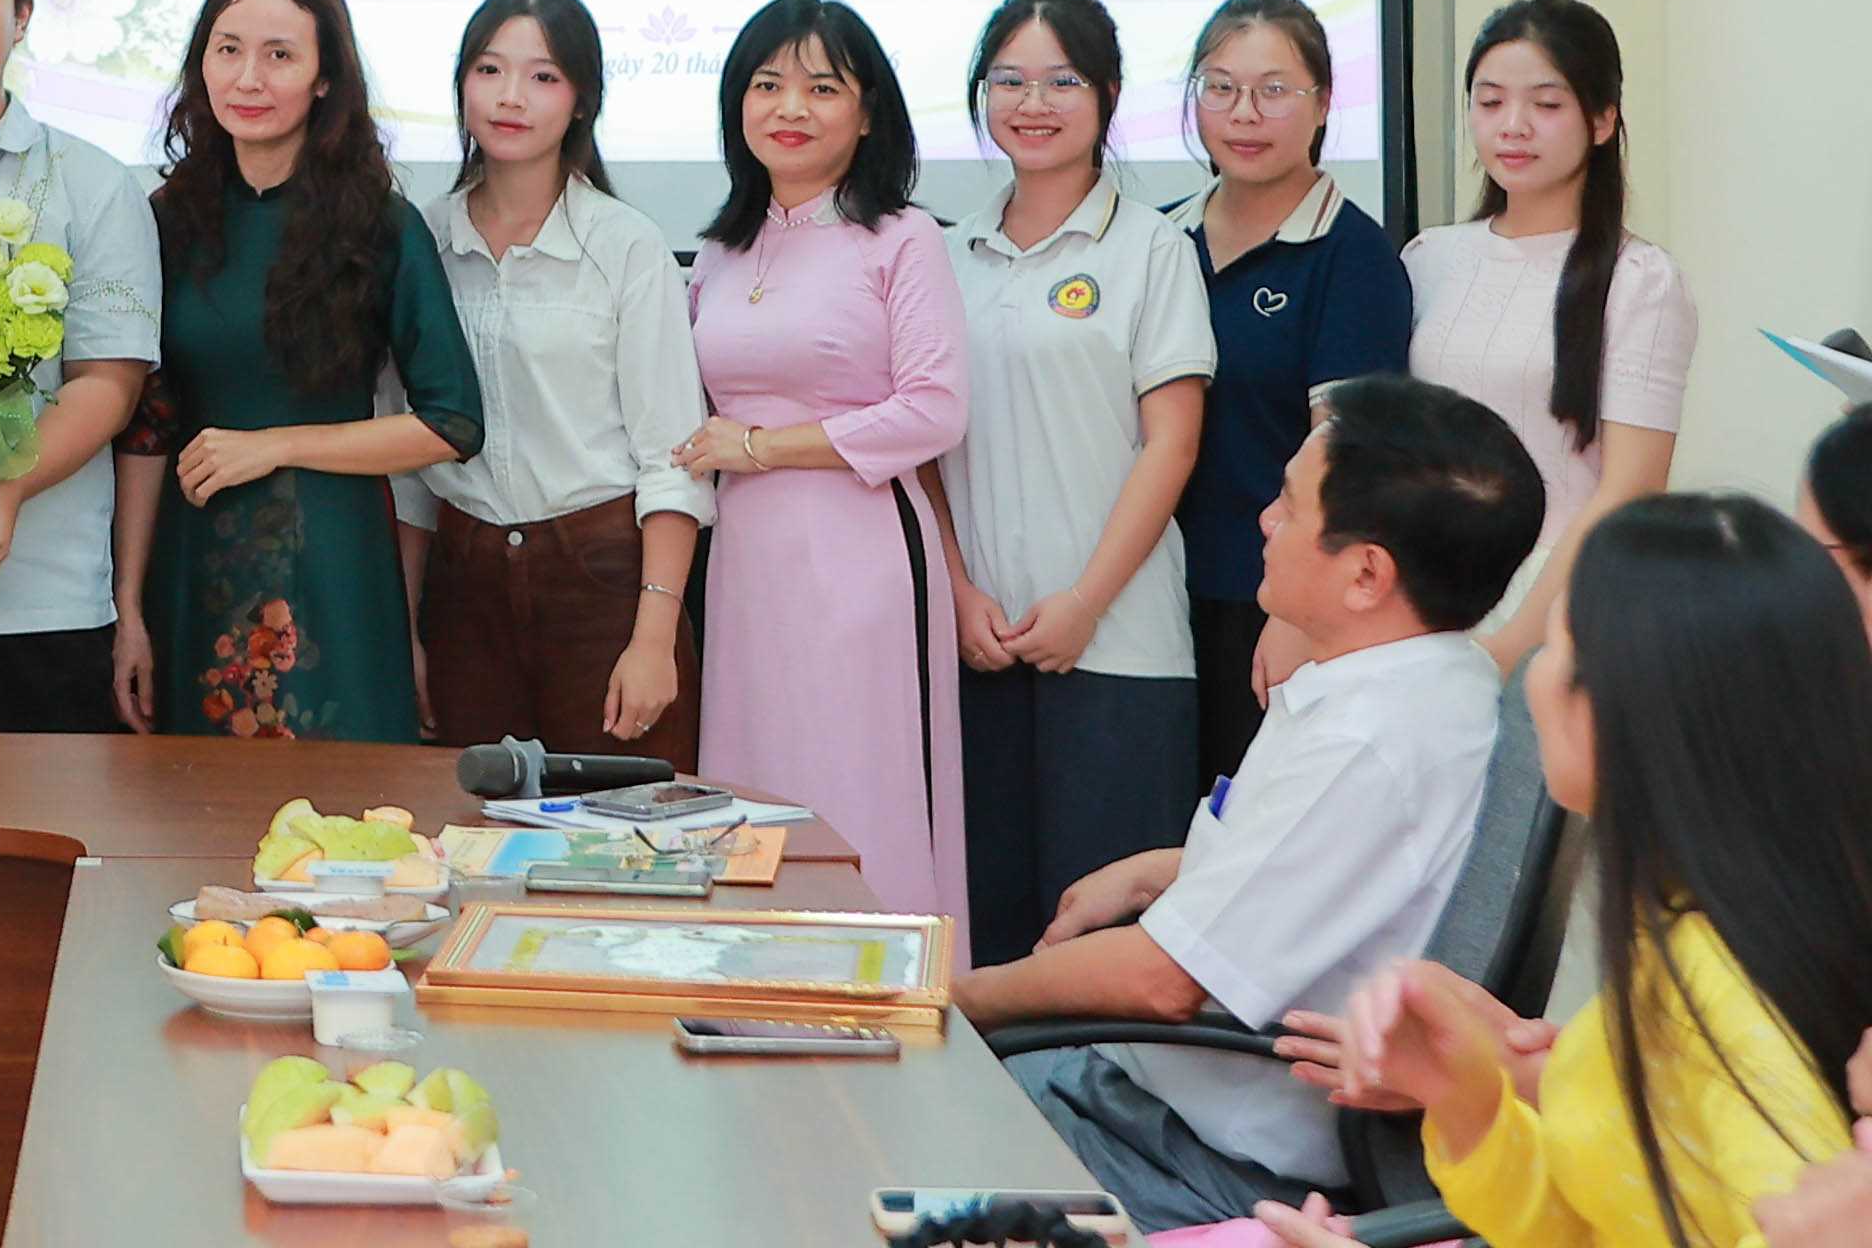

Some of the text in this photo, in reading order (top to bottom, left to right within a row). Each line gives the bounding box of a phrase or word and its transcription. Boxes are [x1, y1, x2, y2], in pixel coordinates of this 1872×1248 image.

[602, 50, 722, 81] gày 20 thá
